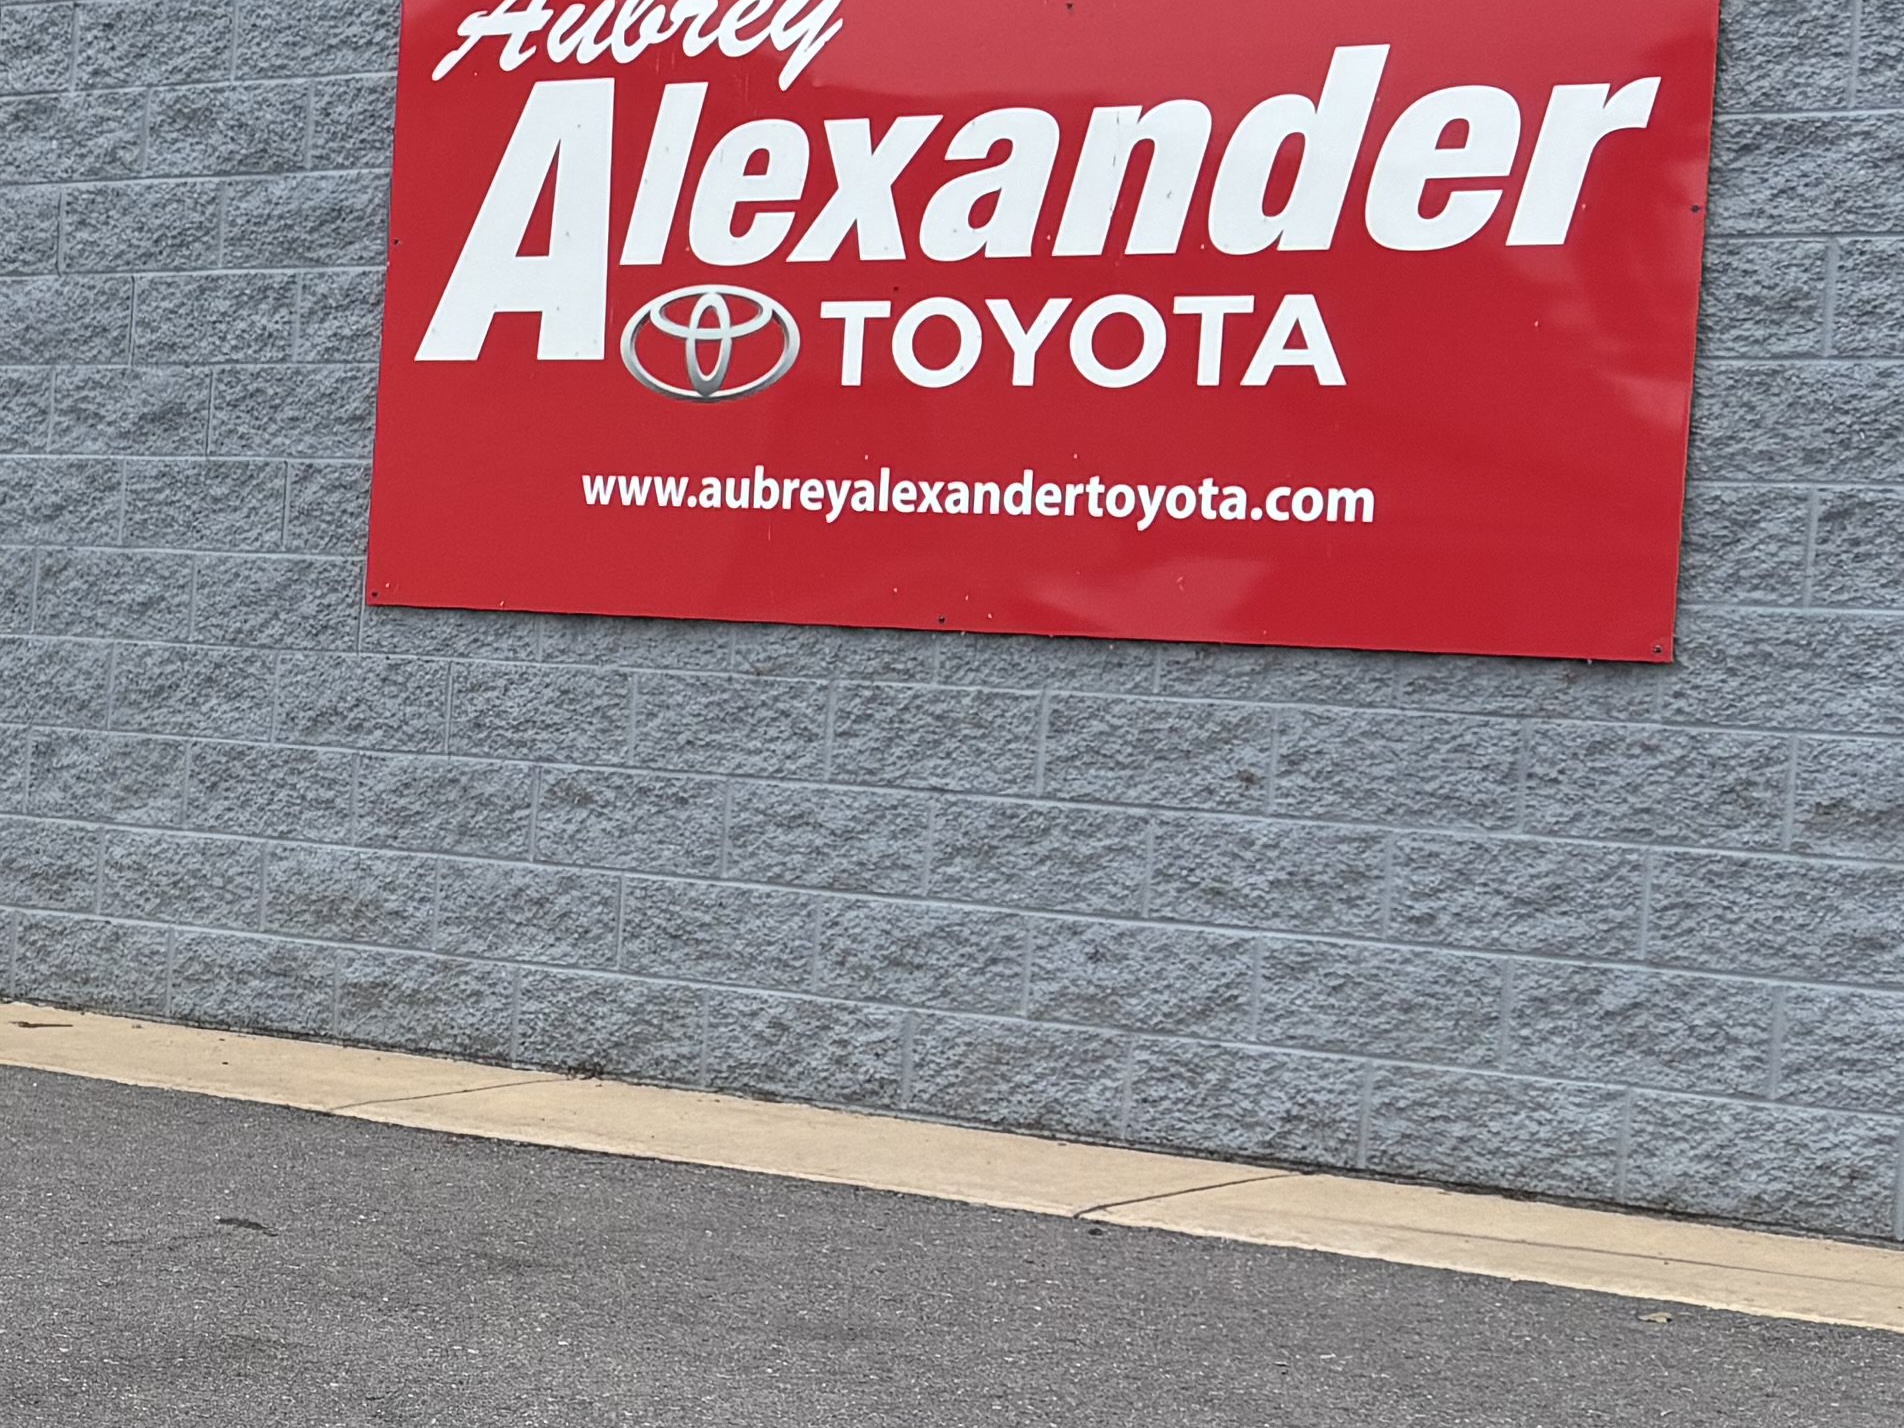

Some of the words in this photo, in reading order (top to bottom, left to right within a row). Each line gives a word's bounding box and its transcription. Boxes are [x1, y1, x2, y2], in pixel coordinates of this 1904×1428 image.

[414, 43, 1662, 362] Alexander
[820, 294, 1347, 388] TOYOTA
[582, 465, 1375, 532] www.aubreyalexandertoyota.com
